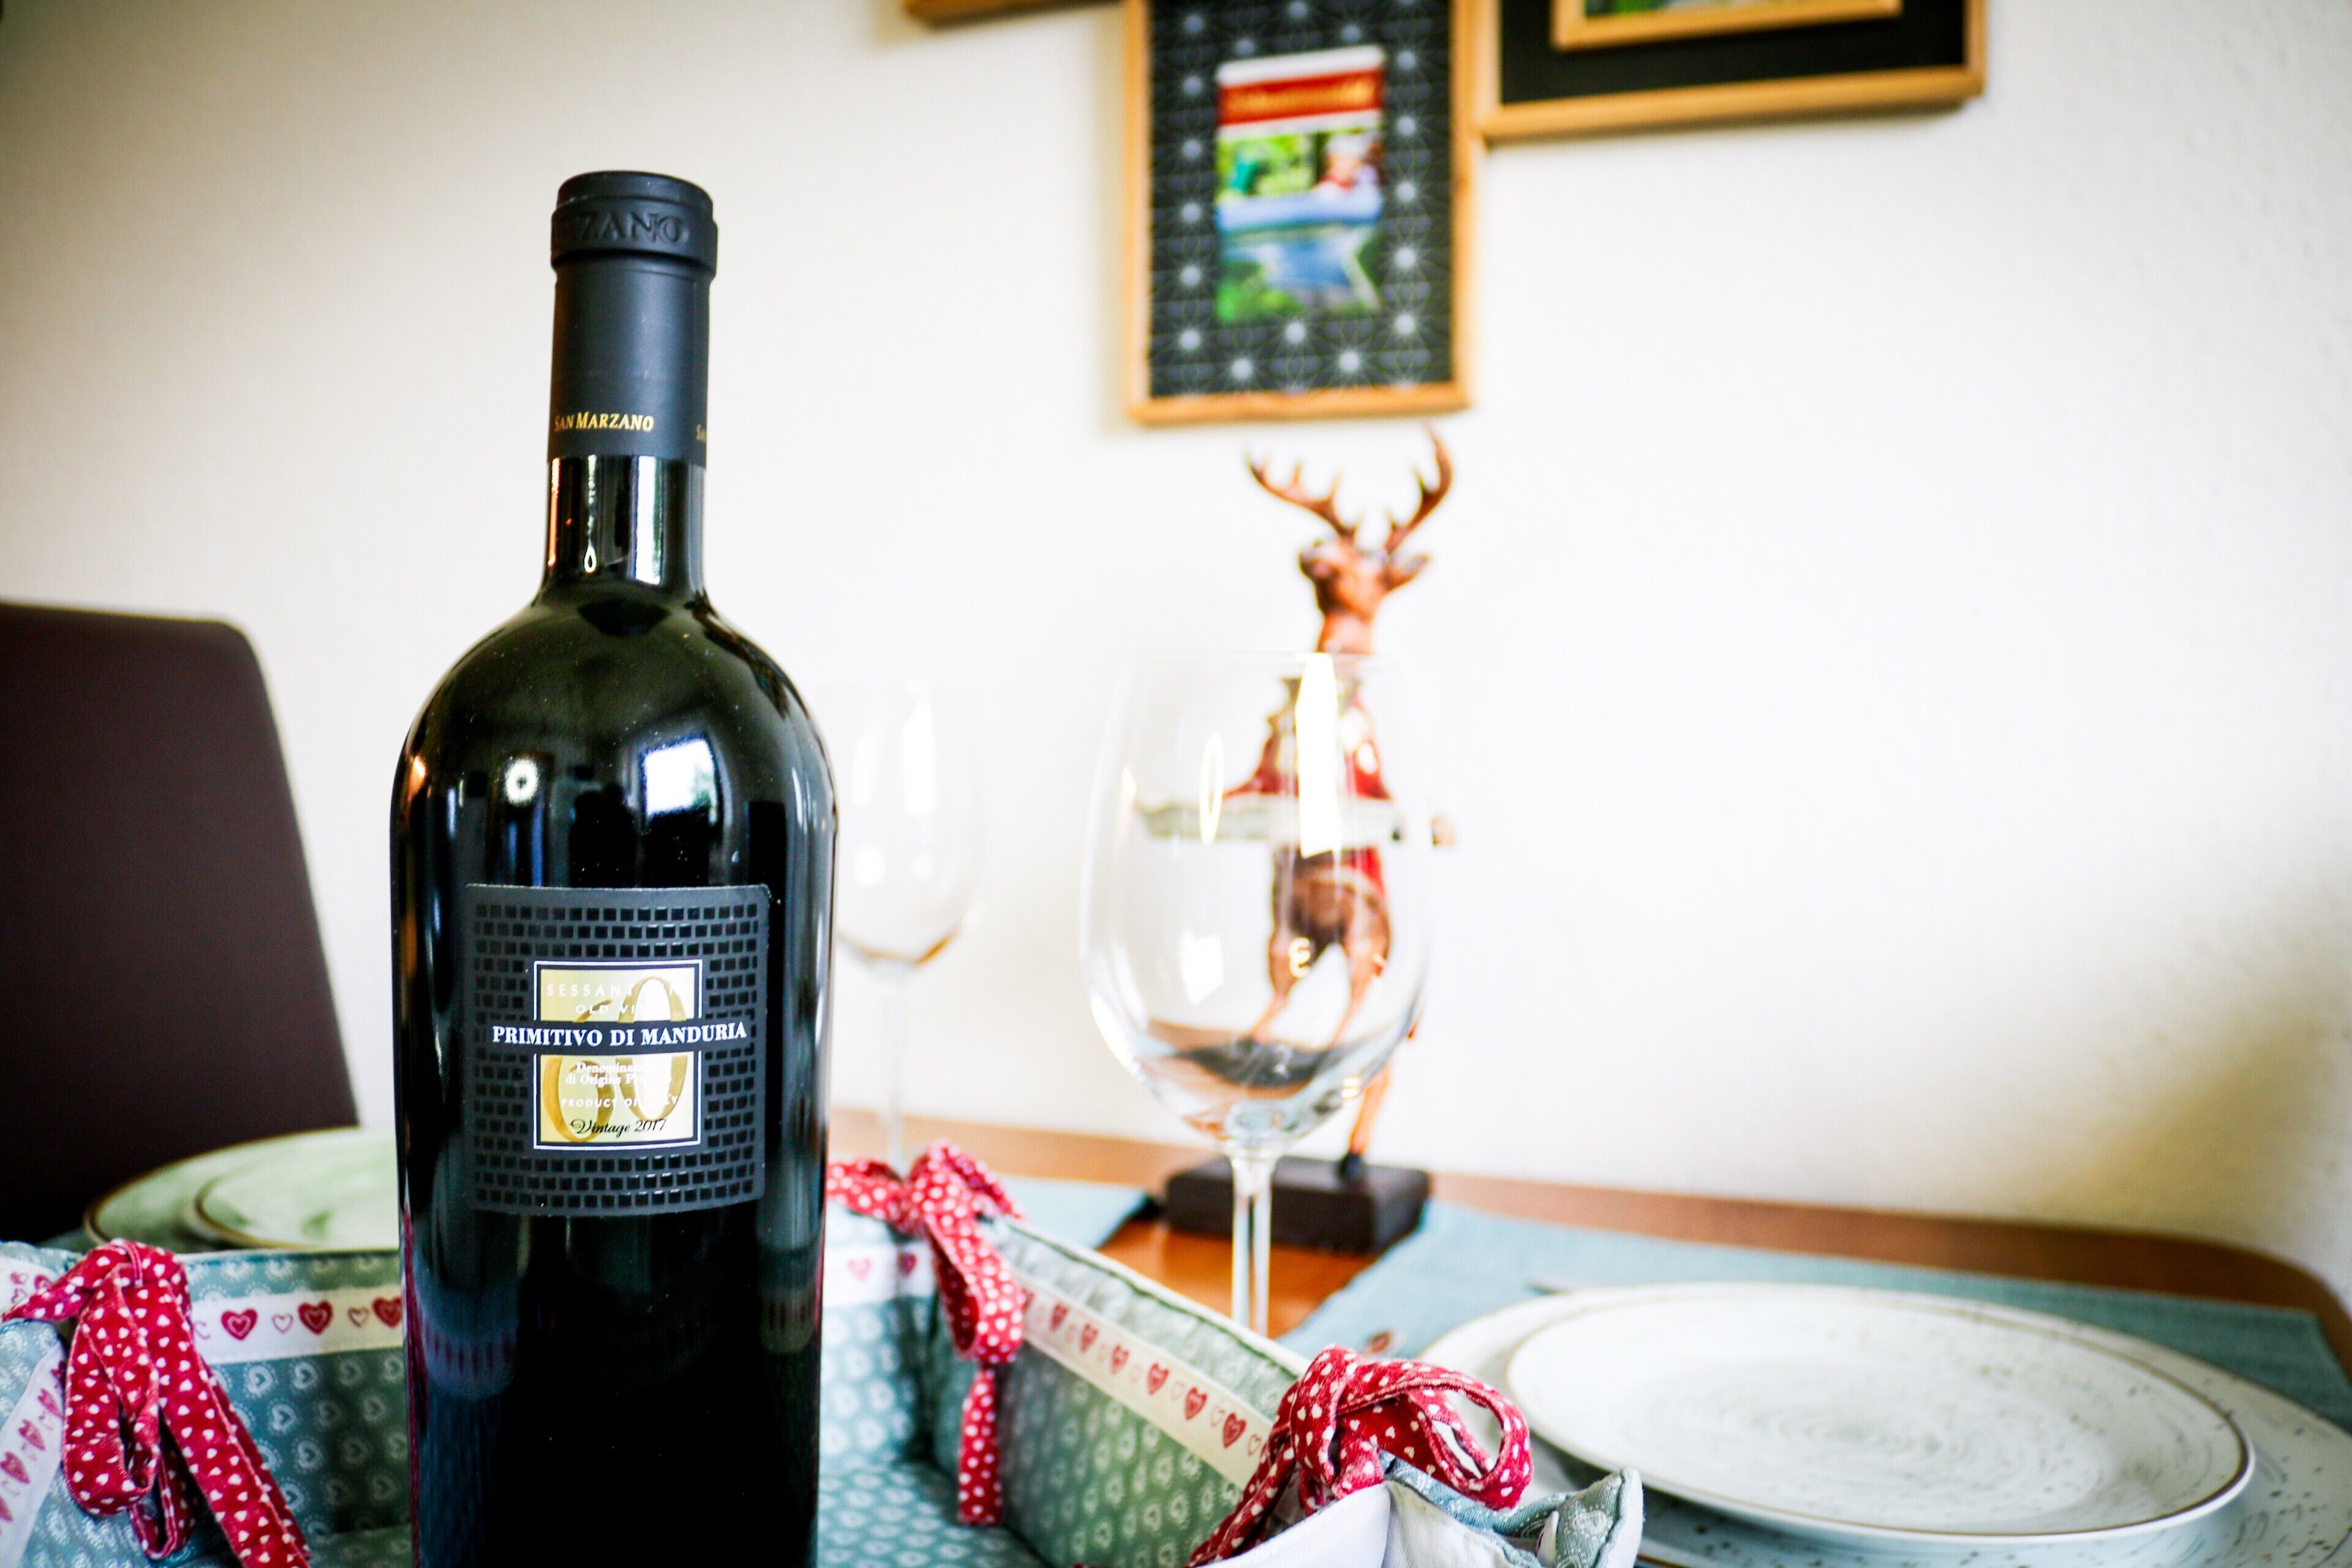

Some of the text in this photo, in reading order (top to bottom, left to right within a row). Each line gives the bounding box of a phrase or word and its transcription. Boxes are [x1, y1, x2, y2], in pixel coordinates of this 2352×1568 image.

[576, 412, 654, 432] MARZANO
[492, 1021, 747, 1046] PRIMITIVO DI MANDURIA
[565, 1074, 576, 1085] di
[560, 1098, 617, 1108] PRODUCT
[570, 1118, 668, 1138] Vintage 2017
